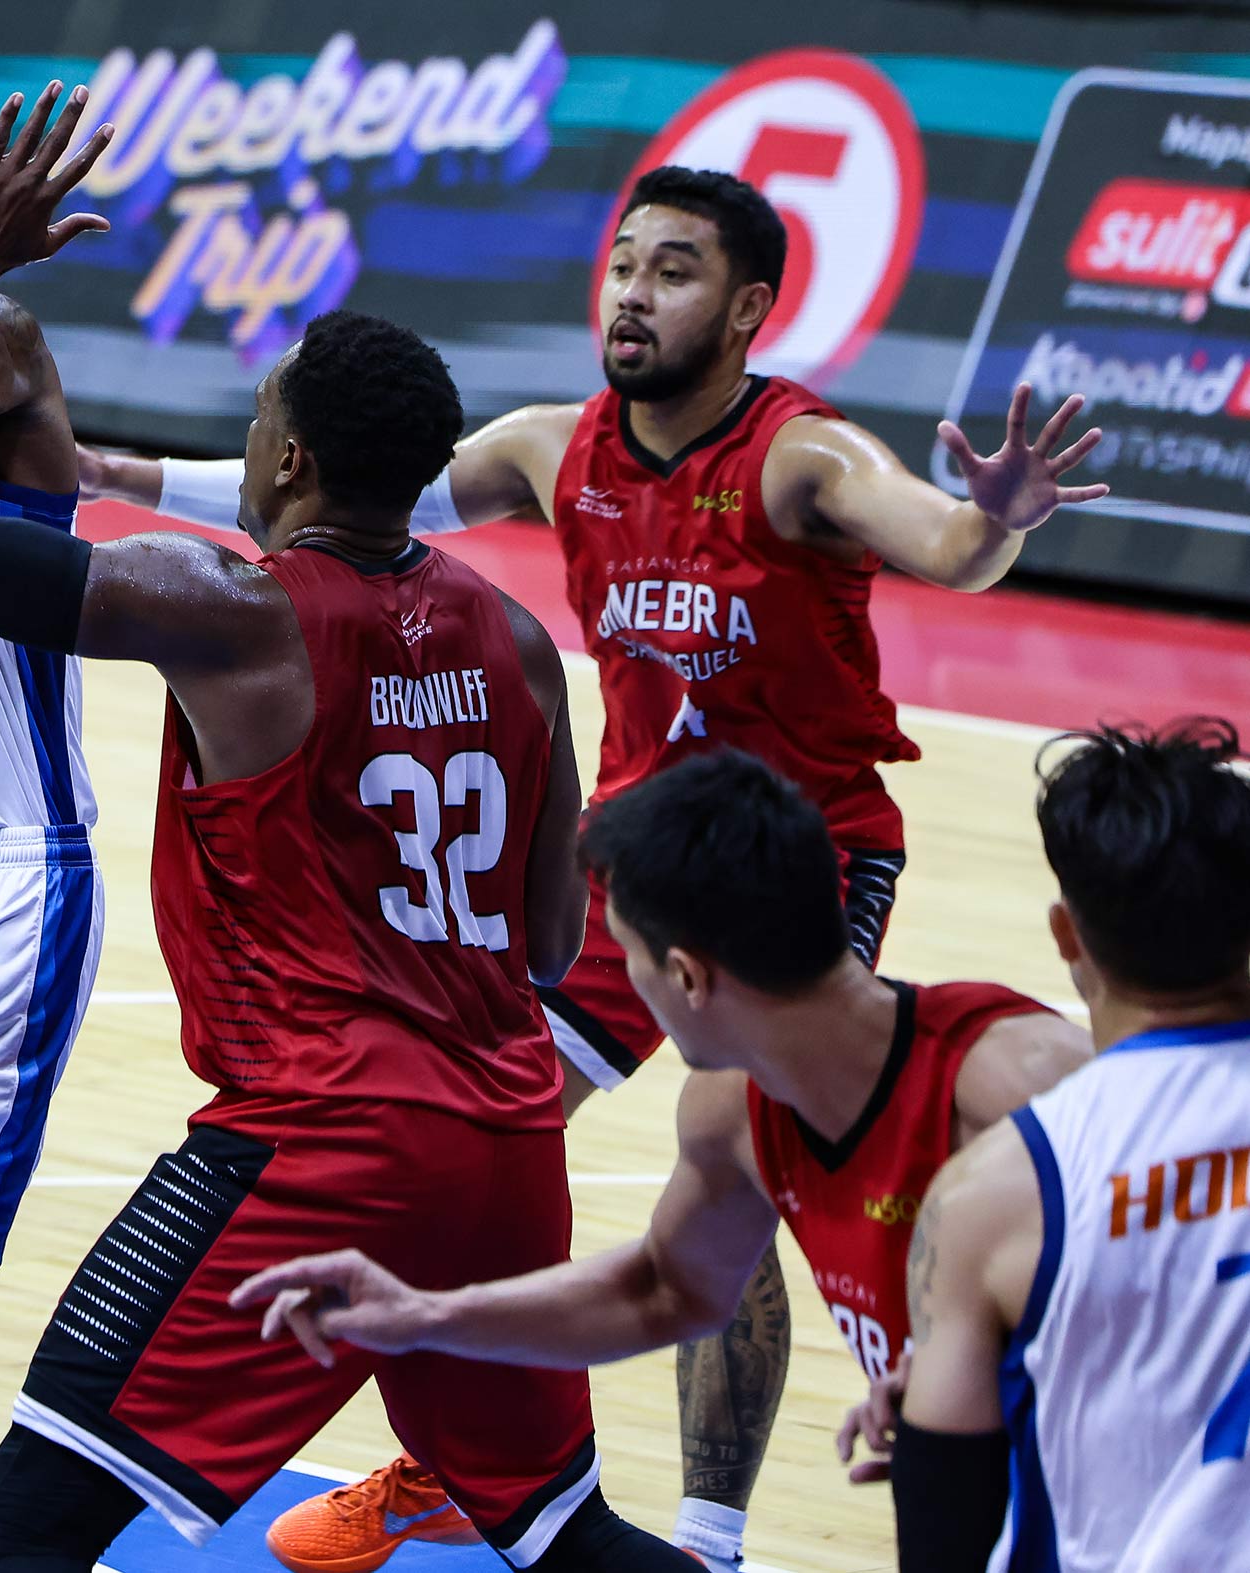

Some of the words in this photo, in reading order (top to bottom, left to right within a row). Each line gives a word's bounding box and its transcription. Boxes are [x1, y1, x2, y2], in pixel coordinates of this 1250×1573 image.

[50, 18, 558, 198] Weekend
[130, 178, 352, 345] Trip
[1086, 198, 1235, 280] sulit
[358, 751, 510, 952] 32
